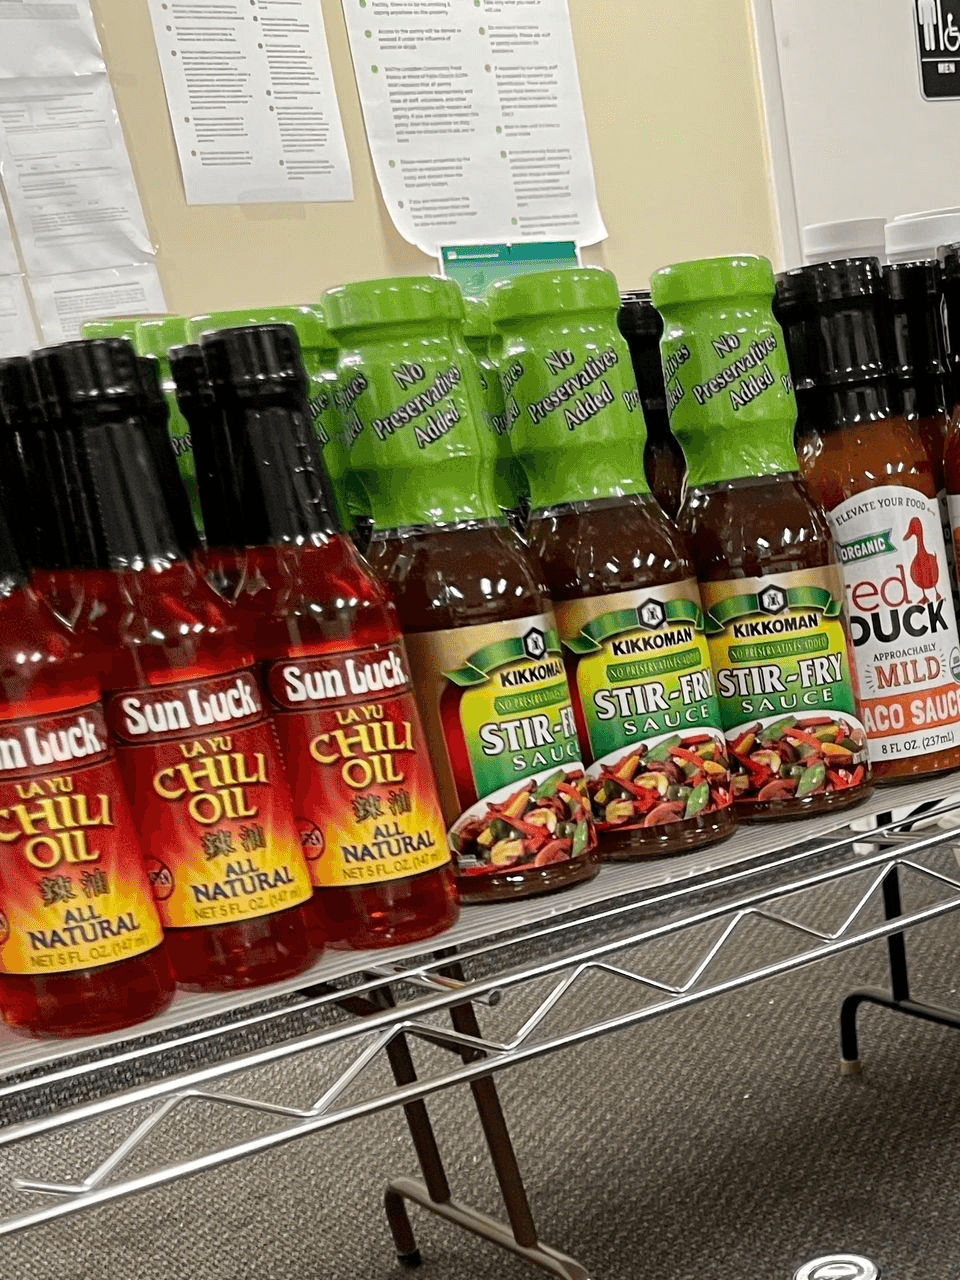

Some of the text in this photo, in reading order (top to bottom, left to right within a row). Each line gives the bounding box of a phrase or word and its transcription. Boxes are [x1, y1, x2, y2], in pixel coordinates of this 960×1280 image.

[937, 62, 956, 74] MEN
[543, 348, 576, 375] No
[709, 330, 741, 359] No
[392, 362, 425, 391] No
[526, 346, 619, 426] Preservatives
[692, 332, 778, 405] Preservatives
[371, 364, 462, 441] Preservatives
[727, 366, 775, 411] Added
[562, 382, 614, 431] Added
[413, 404, 461, 449] Added
[836, 497, 926, 526] ELEVATE YOUR FOOD
[840, 539, 886, 563] ORGANIC
[611, 626, 694, 656] KIKKOMAN
[732, 614, 820, 639] KIKKOMAN
[872, 642, 937, 663] APPROACHABLY
[282, 650, 407, 702] Sun Luck
[718, 652, 844, 699] STIR-FRY
[876, 655, 942, 690] MILD
[121, 679, 258, 735] Sun Luck
[593, 668, 714, 720] STIR-FRY
[741, 688, 834, 715] SAUCE
[335, 704, 384, 725] LA YU
[623, 704, 710, 735] SAUCE
[863, 703, 905, 734] ACO
[24, 716, 103, 766] Luck
[309, 720, 417, 764] CHILI
[881, 743, 889, 755] 8
[889, 741, 903, 754] FL
[16, 776, 73, 799] LA YU
[153, 752, 270, 800] CHILI
[341, 753, 404, 788] OIL
[0, 794, 115, 841] CHILI
[188, 786, 258, 824] OIL
[25, 829, 100, 868] OIL
[340, 829, 436, 863] NATURAL
[373, 822, 405, 840] ALL
[190, 866, 295, 904] NATURAL
[225, 858, 260, 879] ALL
[28, 911, 141, 950] NATURAL
[63, 904, 103, 926] ALL
